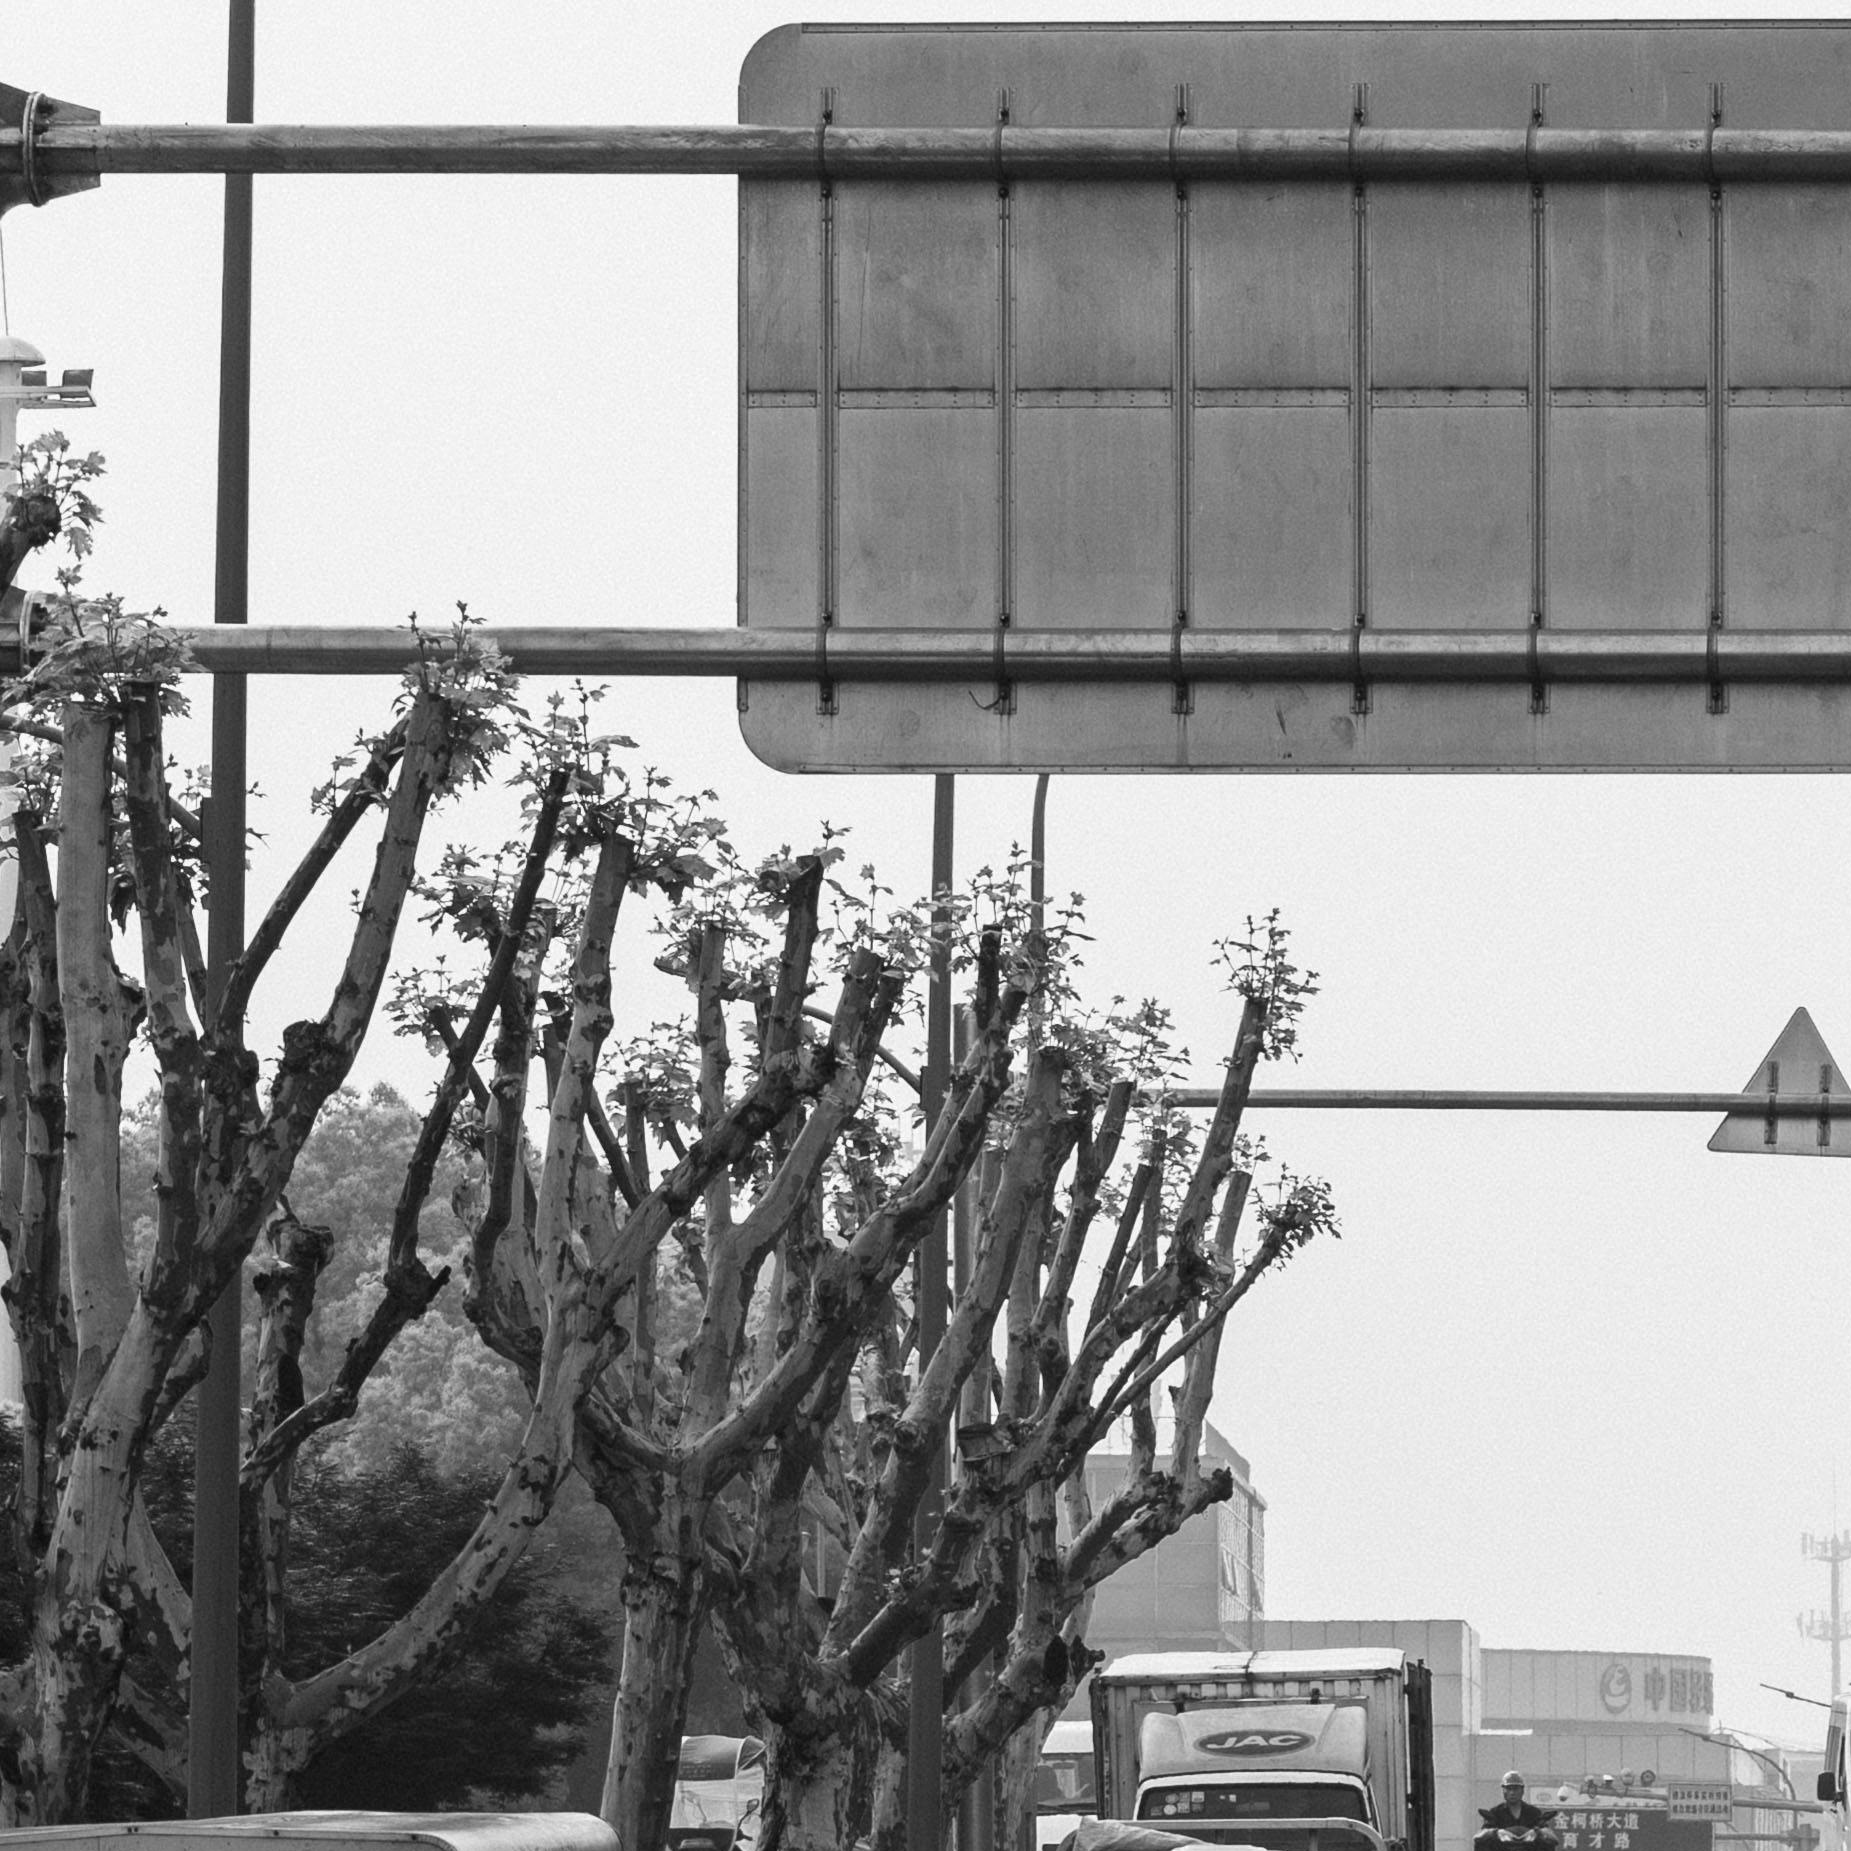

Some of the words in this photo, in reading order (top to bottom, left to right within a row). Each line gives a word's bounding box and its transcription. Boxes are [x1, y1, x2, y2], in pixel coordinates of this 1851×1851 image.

[1206, 1735, 1302, 1749] JAC
[1554, 1811, 1640, 1830] 金柯桥大道
[1562, 1832, 1631, 1849] 育才路
